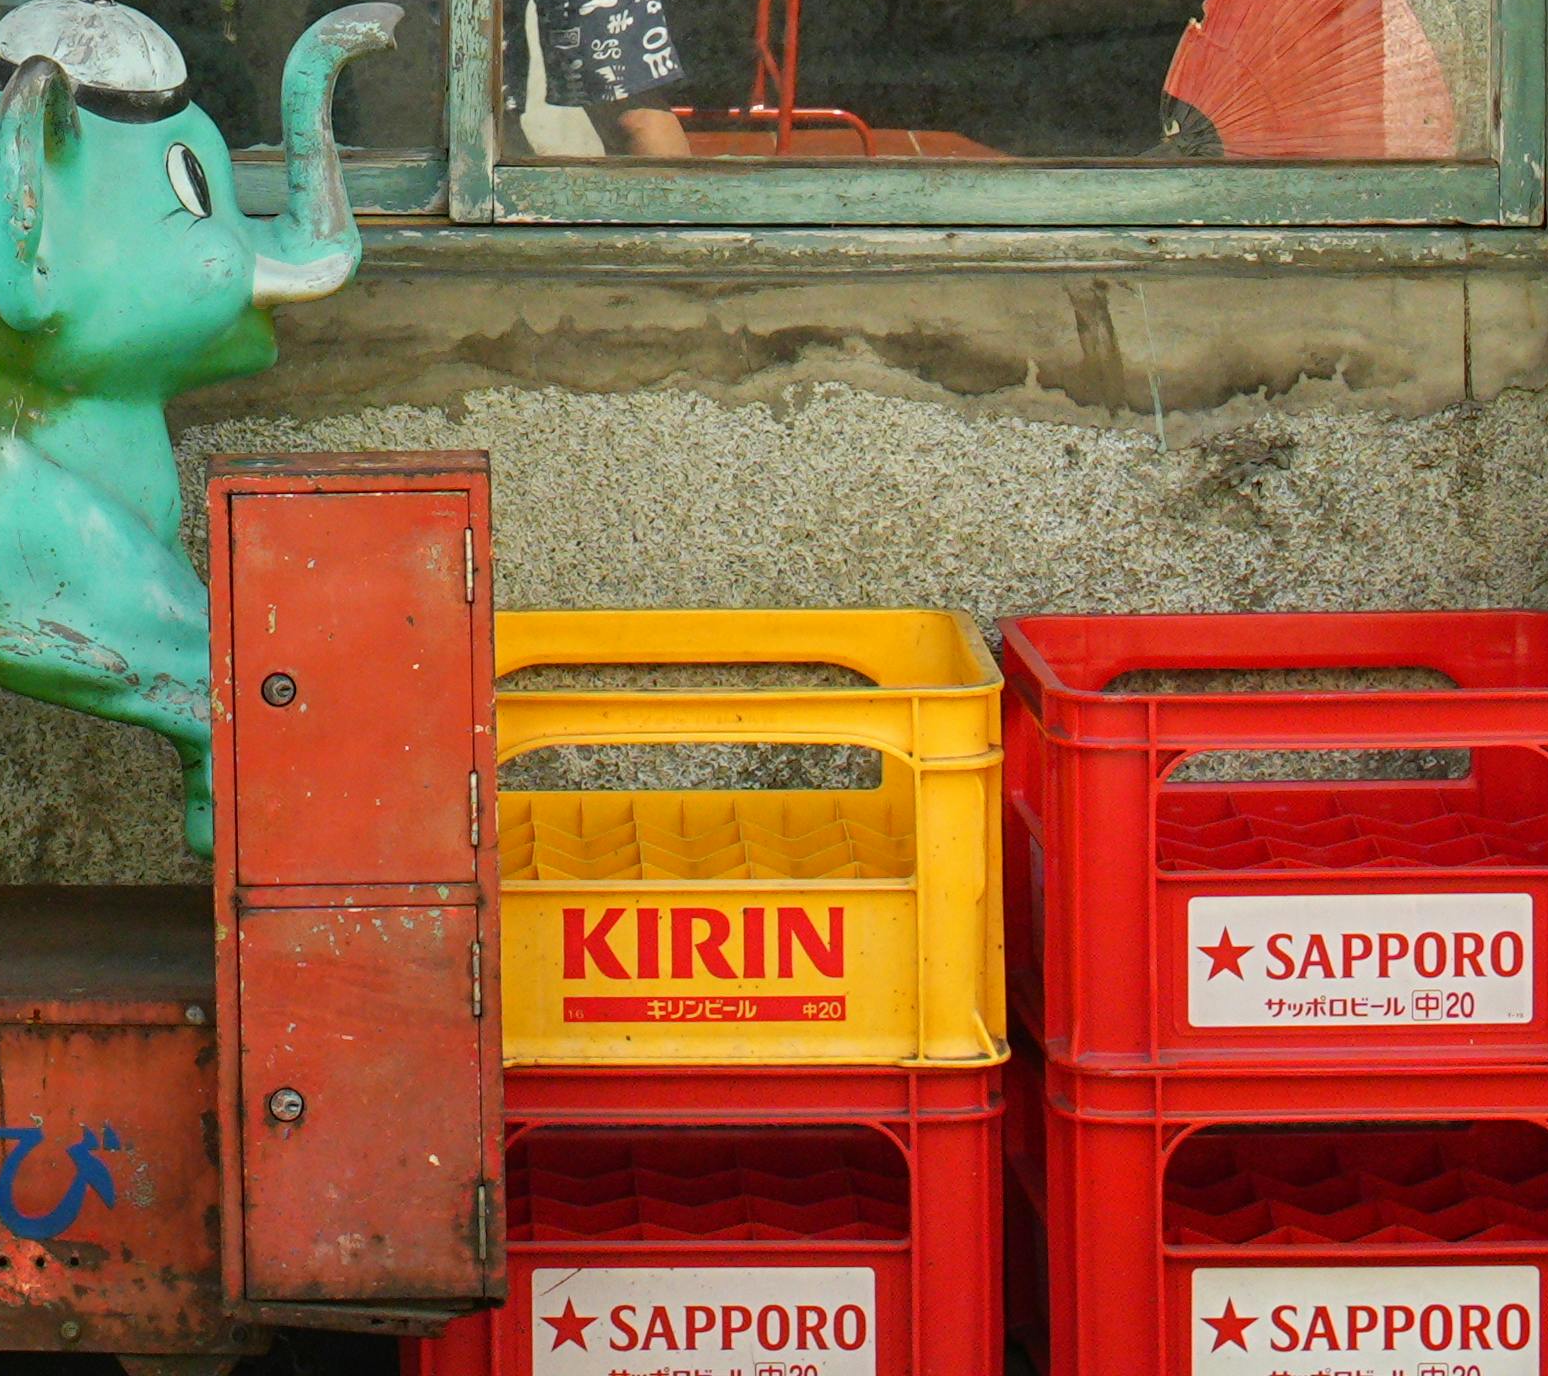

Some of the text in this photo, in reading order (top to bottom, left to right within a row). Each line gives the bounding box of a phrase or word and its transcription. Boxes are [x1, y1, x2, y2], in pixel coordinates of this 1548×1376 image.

[562, 906, 844, 979] KIRIN
[1265, 930, 1525, 981] SAPPORO
[647, 1000, 757, 1020] キリンビール
[1265, 995, 1406, 1018] サッポロビール
[608, 1303, 867, 1352] SAPPORO
[1270, 1303, 1531, 1352] SAPPORO
